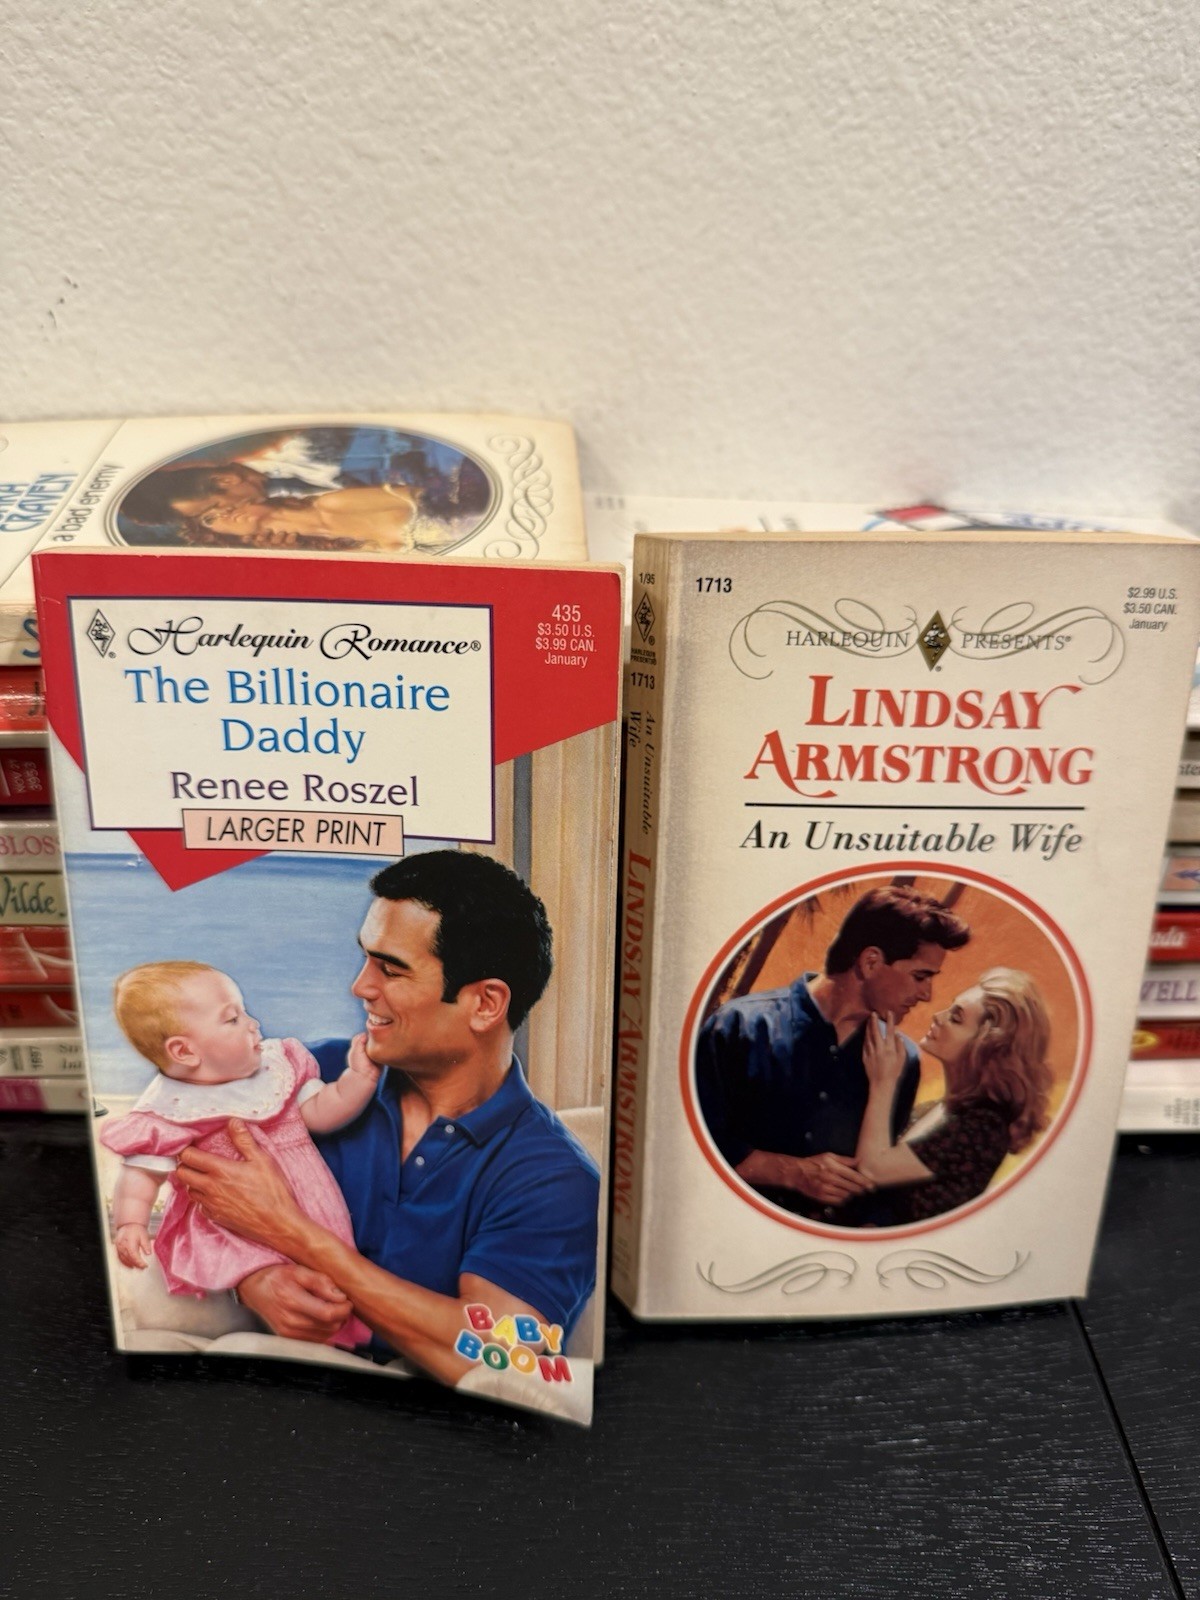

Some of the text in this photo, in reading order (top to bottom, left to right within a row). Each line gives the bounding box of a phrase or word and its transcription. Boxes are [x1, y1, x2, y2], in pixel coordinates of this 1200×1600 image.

[0, 472, 78, 533] CRAVEN
[54, 507, 94, 532] bad
[79, 463, 125, 506] enemy
[638, 571, 656, 586] 1/95
[695, 577, 733, 593] 1713
[1127, 586, 1178, 600] $2.99 U.S.
[551, 604, 582, 622] 435
[1123, 602, 1177, 615] $3.50 CAN.
[1128, 618, 1168, 632] January
[127, 616, 313, 658] Harlequin
[535, 636, 598, 653] $3.99 CAN.
[537, 622, 596, 638] $3.50 U.S.
[785, 630, 911, 653] HARLEQUIN
[544, 652, 588, 669] January
[124, 665, 451, 713] The Billionaire
[630, 671, 656, 690] 1713
[804, 674, 1083, 730] LINDSAY
[220, 715, 367, 764] Daddy
[627, 710, 642, 748] Wife
[642, 709, 657, 835] An Unsuitable
[743, 729, 1095, 799] ARMSTRONG
[170, 770, 420, 807] Renee Roszel
[206, 816, 387, 847] LARGER PRINT
[739, 819, 1083, 862] An Unsuitable Wife
[623, 848, 652, 1022] LINDSAY
[613, 1008, 644, 1219] ARMSTRONG
[463, 1302, 564, 1355] BABY
[454, 1328, 575, 1384] BOOM
